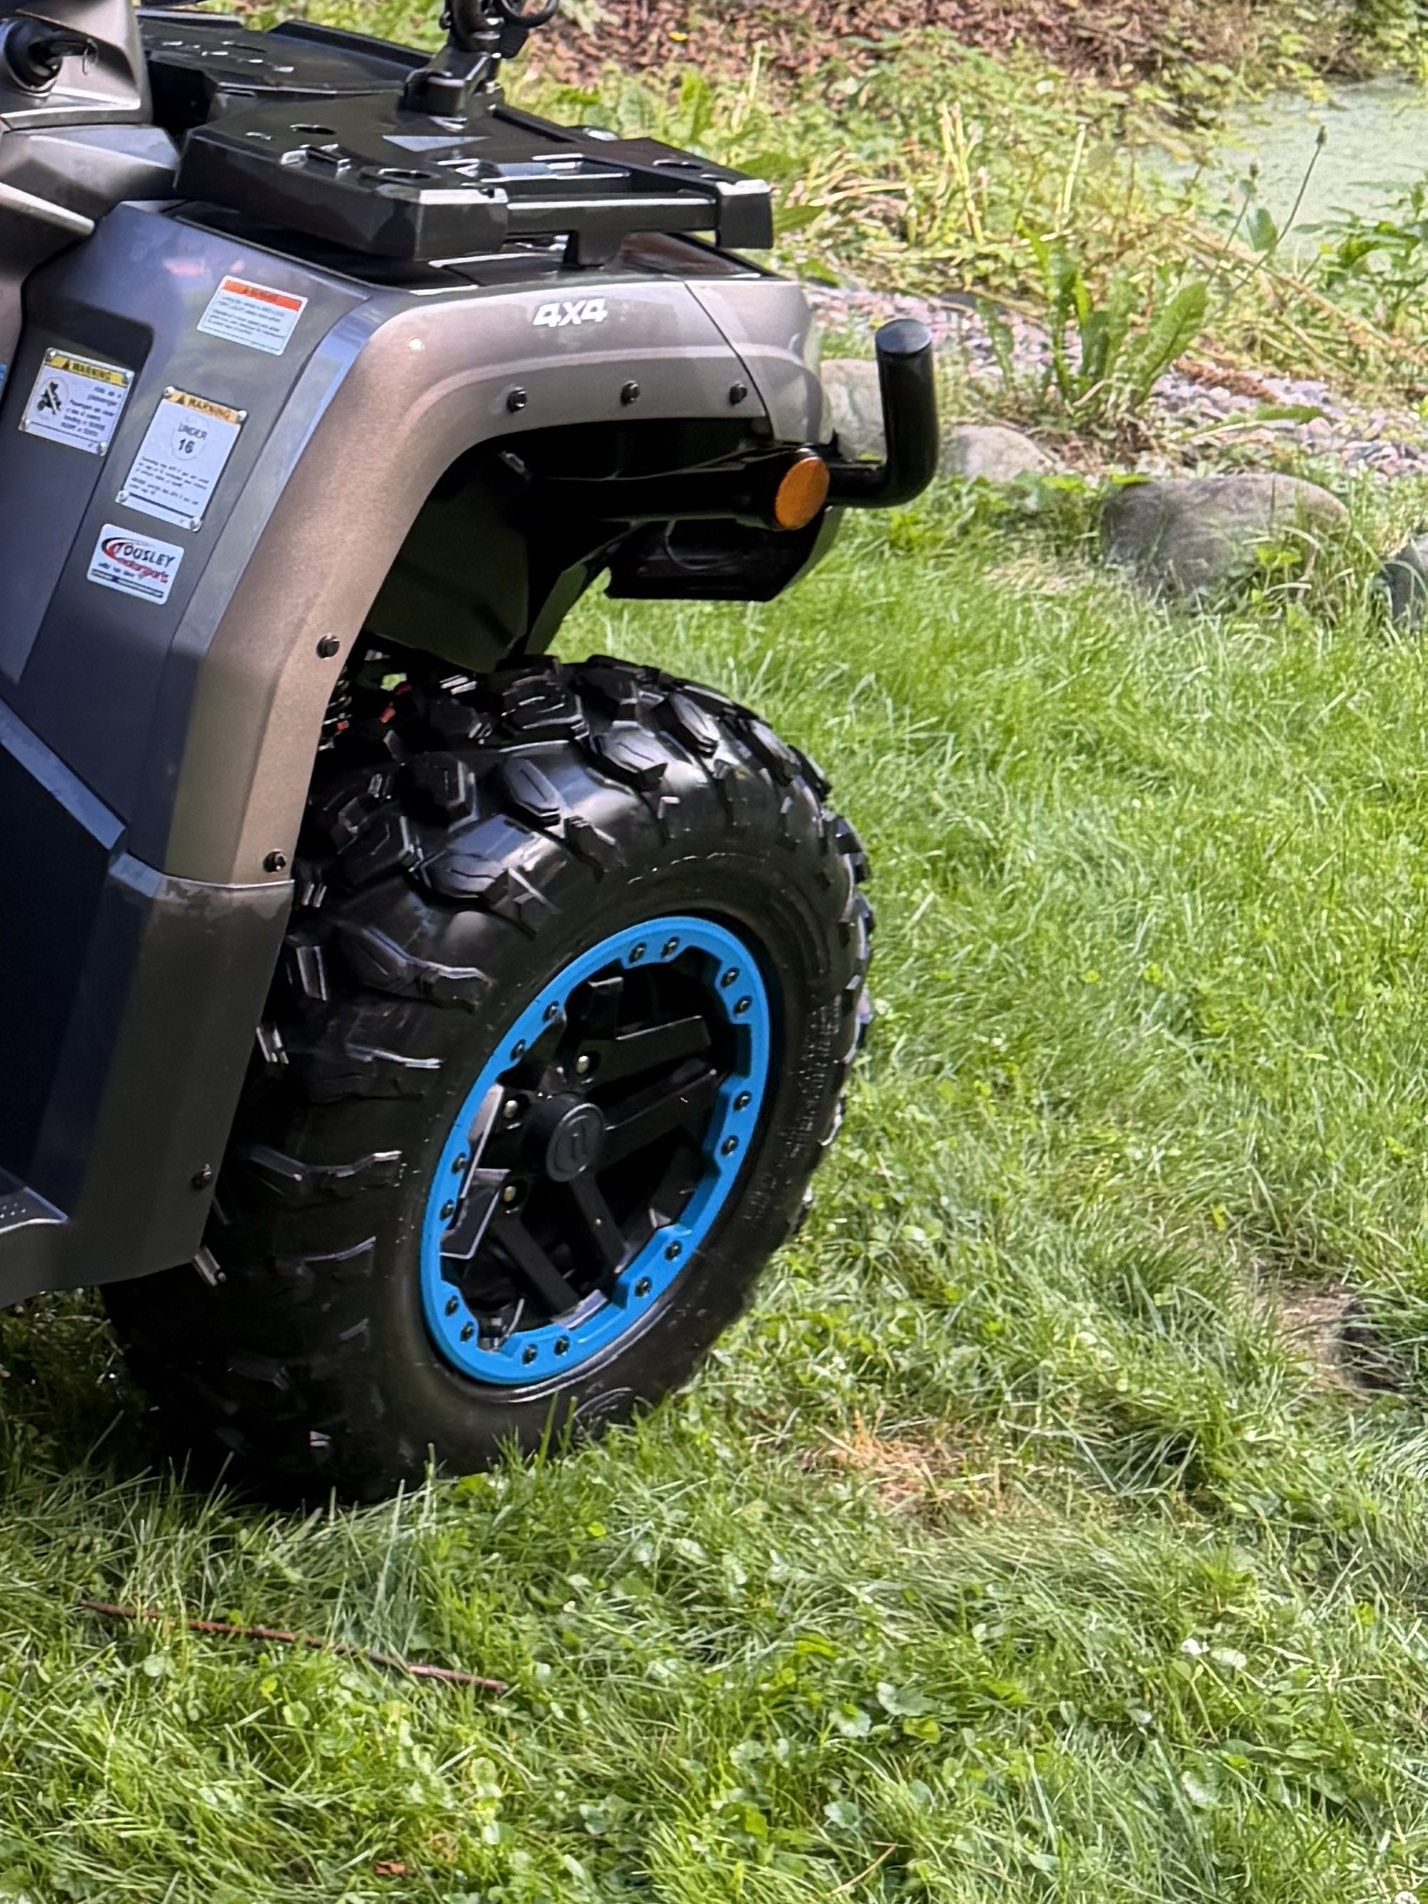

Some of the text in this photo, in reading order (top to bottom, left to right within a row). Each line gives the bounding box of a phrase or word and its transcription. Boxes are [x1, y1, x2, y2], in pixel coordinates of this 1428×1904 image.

[178, 423, 208, 440] UNDER
[178, 438, 196, 454] 16
[114, 544, 176, 568] TOUSLEY
